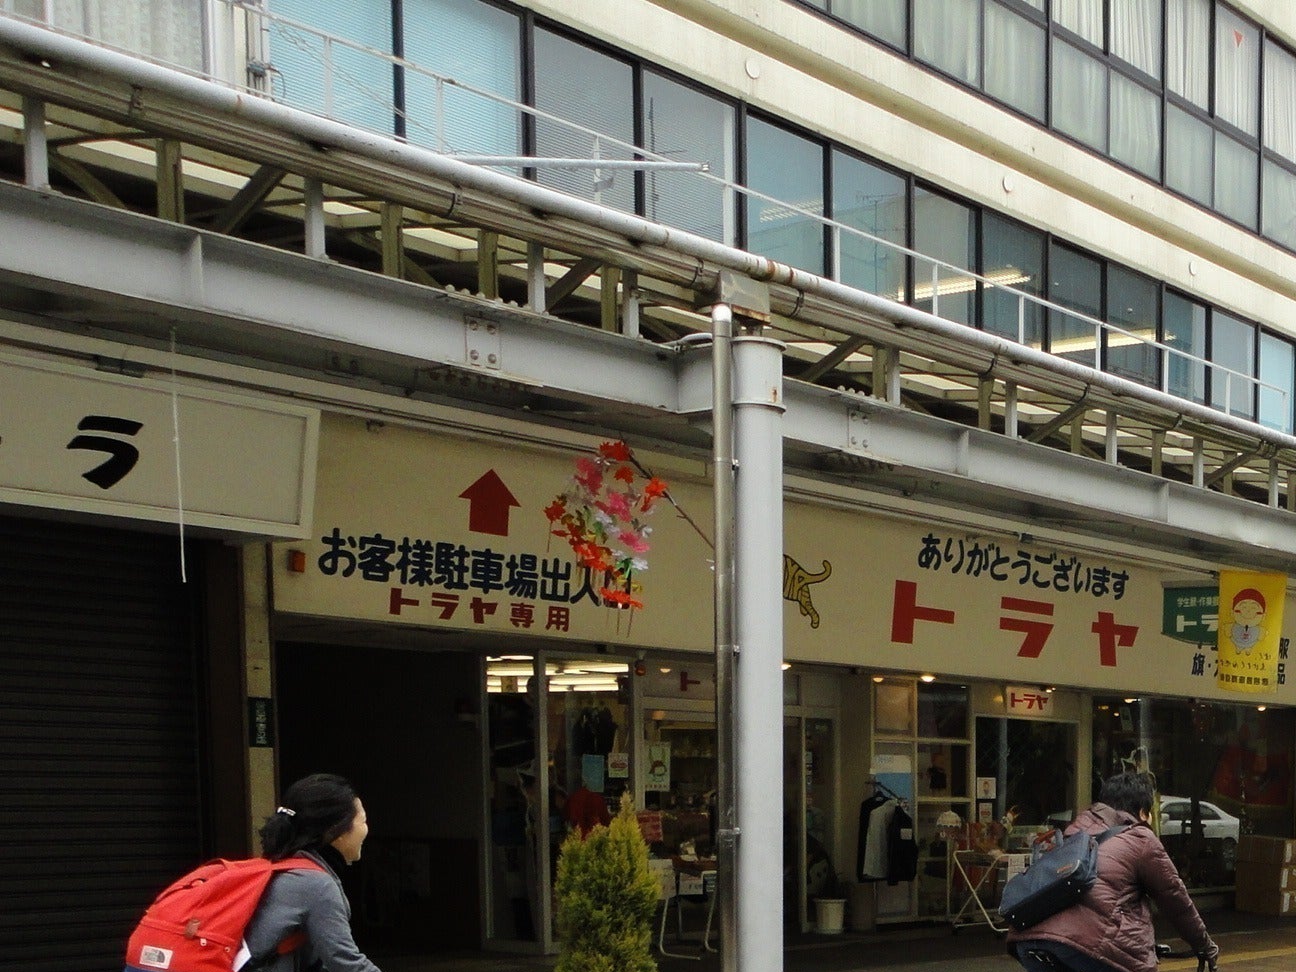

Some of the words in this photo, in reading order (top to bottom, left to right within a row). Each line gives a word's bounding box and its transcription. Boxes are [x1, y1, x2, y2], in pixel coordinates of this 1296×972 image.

[65, 415, 144, 490] ラ
[318, 528, 632, 610] お客様駐車場出入口
[918, 533, 1130, 600] ありがとうございます
[388, 587, 570, 633] トラヤ専用
[891, 579, 1140, 668] トラヤ
[1010, 692, 1049, 711] トラヤ
